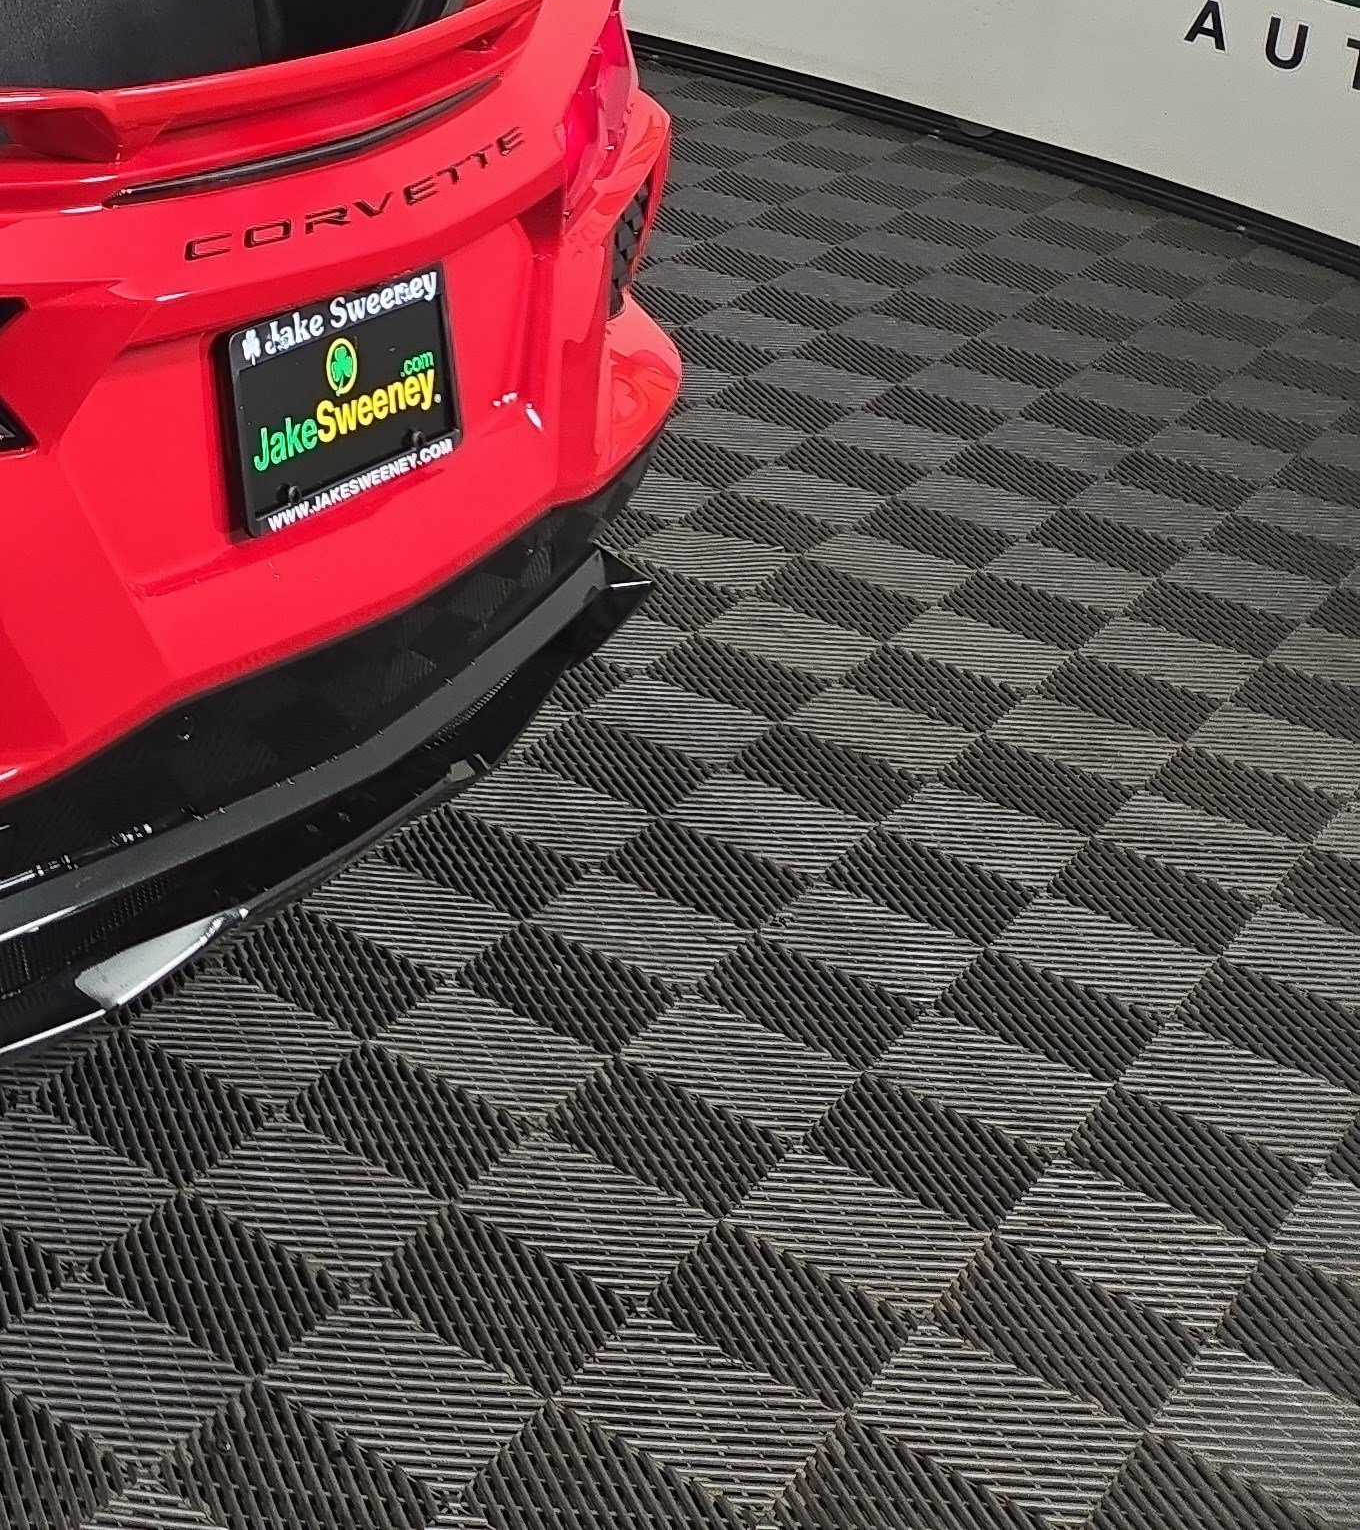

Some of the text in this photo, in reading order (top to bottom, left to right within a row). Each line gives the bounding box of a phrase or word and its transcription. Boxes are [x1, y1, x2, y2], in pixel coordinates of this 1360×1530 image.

[185, 126, 523, 262] CORVETTE
[264, 271, 438, 355] Jake Sweeney
[268, 438, 454, 532] WWW.JAKESWEENEY.COM
